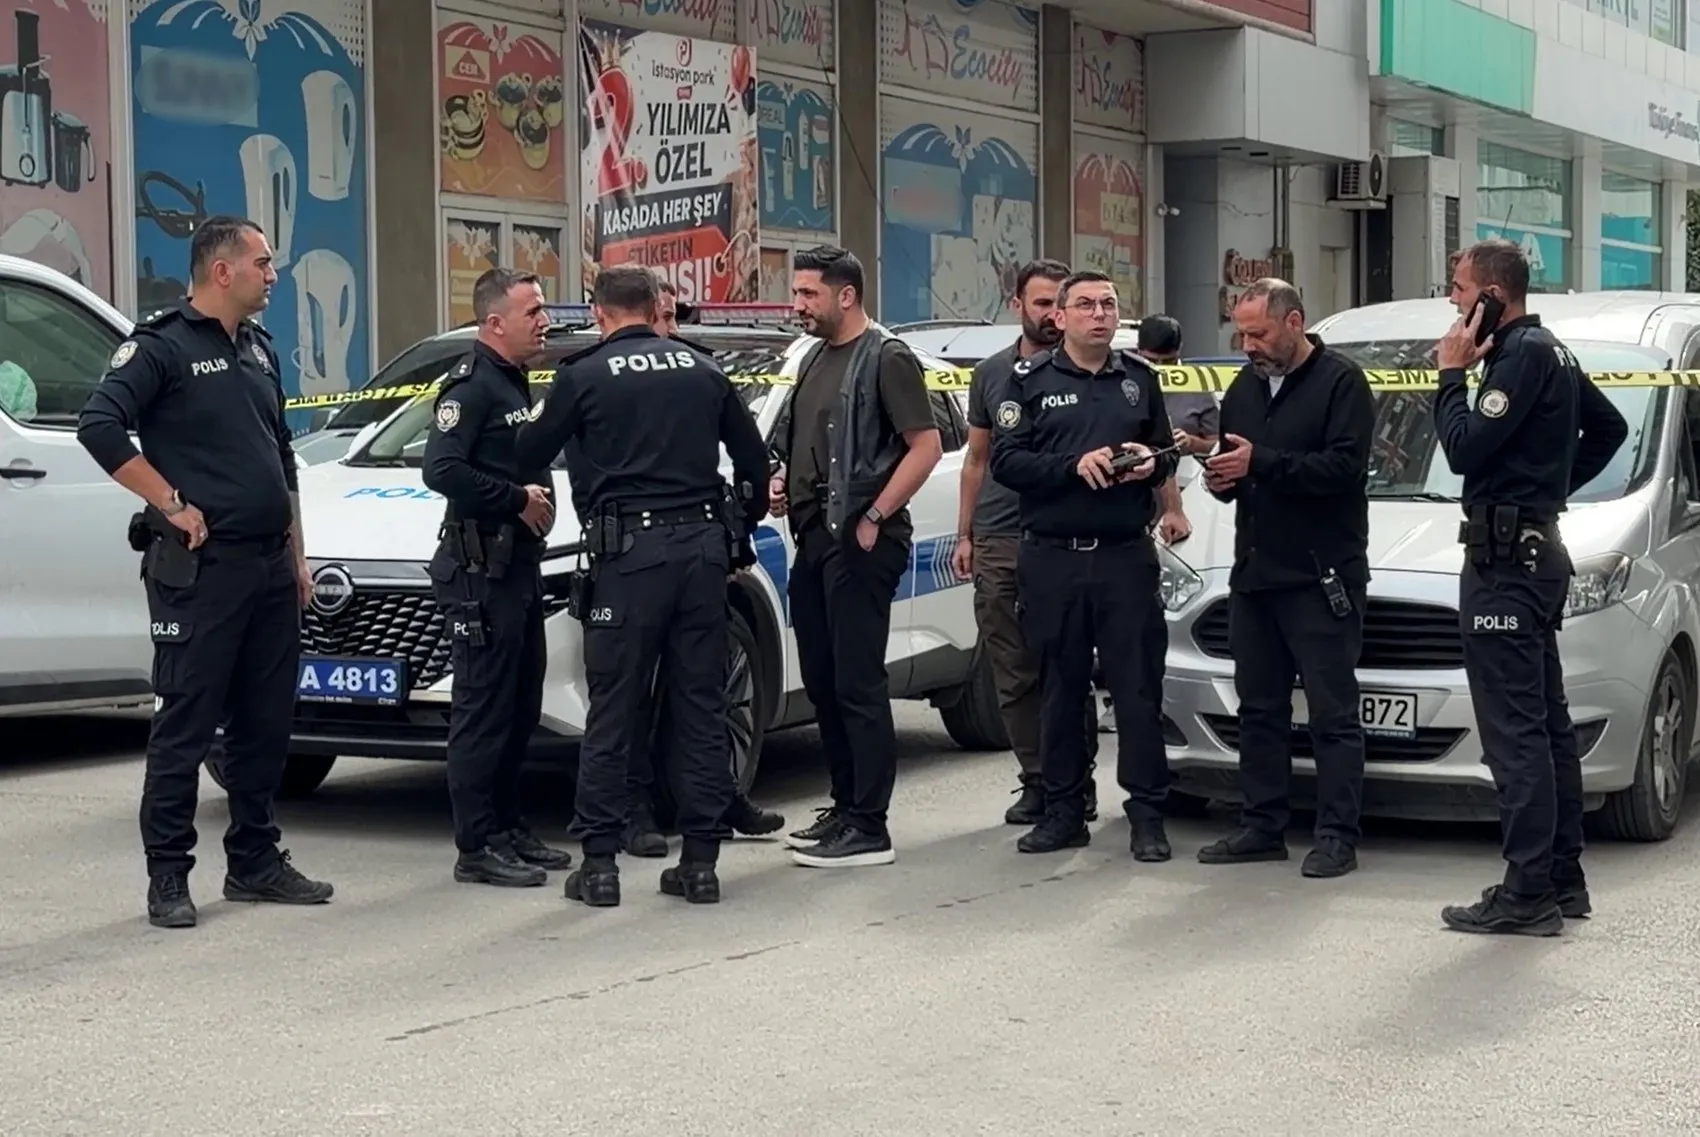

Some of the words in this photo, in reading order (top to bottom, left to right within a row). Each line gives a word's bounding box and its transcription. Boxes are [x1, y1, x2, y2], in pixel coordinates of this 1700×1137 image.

[647, 102, 731, 137] YILIMIZA
[655, 138, 713, 185] ÖZEL
[603, 203, 661, 236] KASADA
[662, 197, 691, 225] HER
[693, 191, 723, 227] ŞEY
[607, 350, 696, 377] POLİS
[299, 664, 321, 690] A
[327, 666, 398, 693] 4813
[1362, 697, 1409, 726] 872
